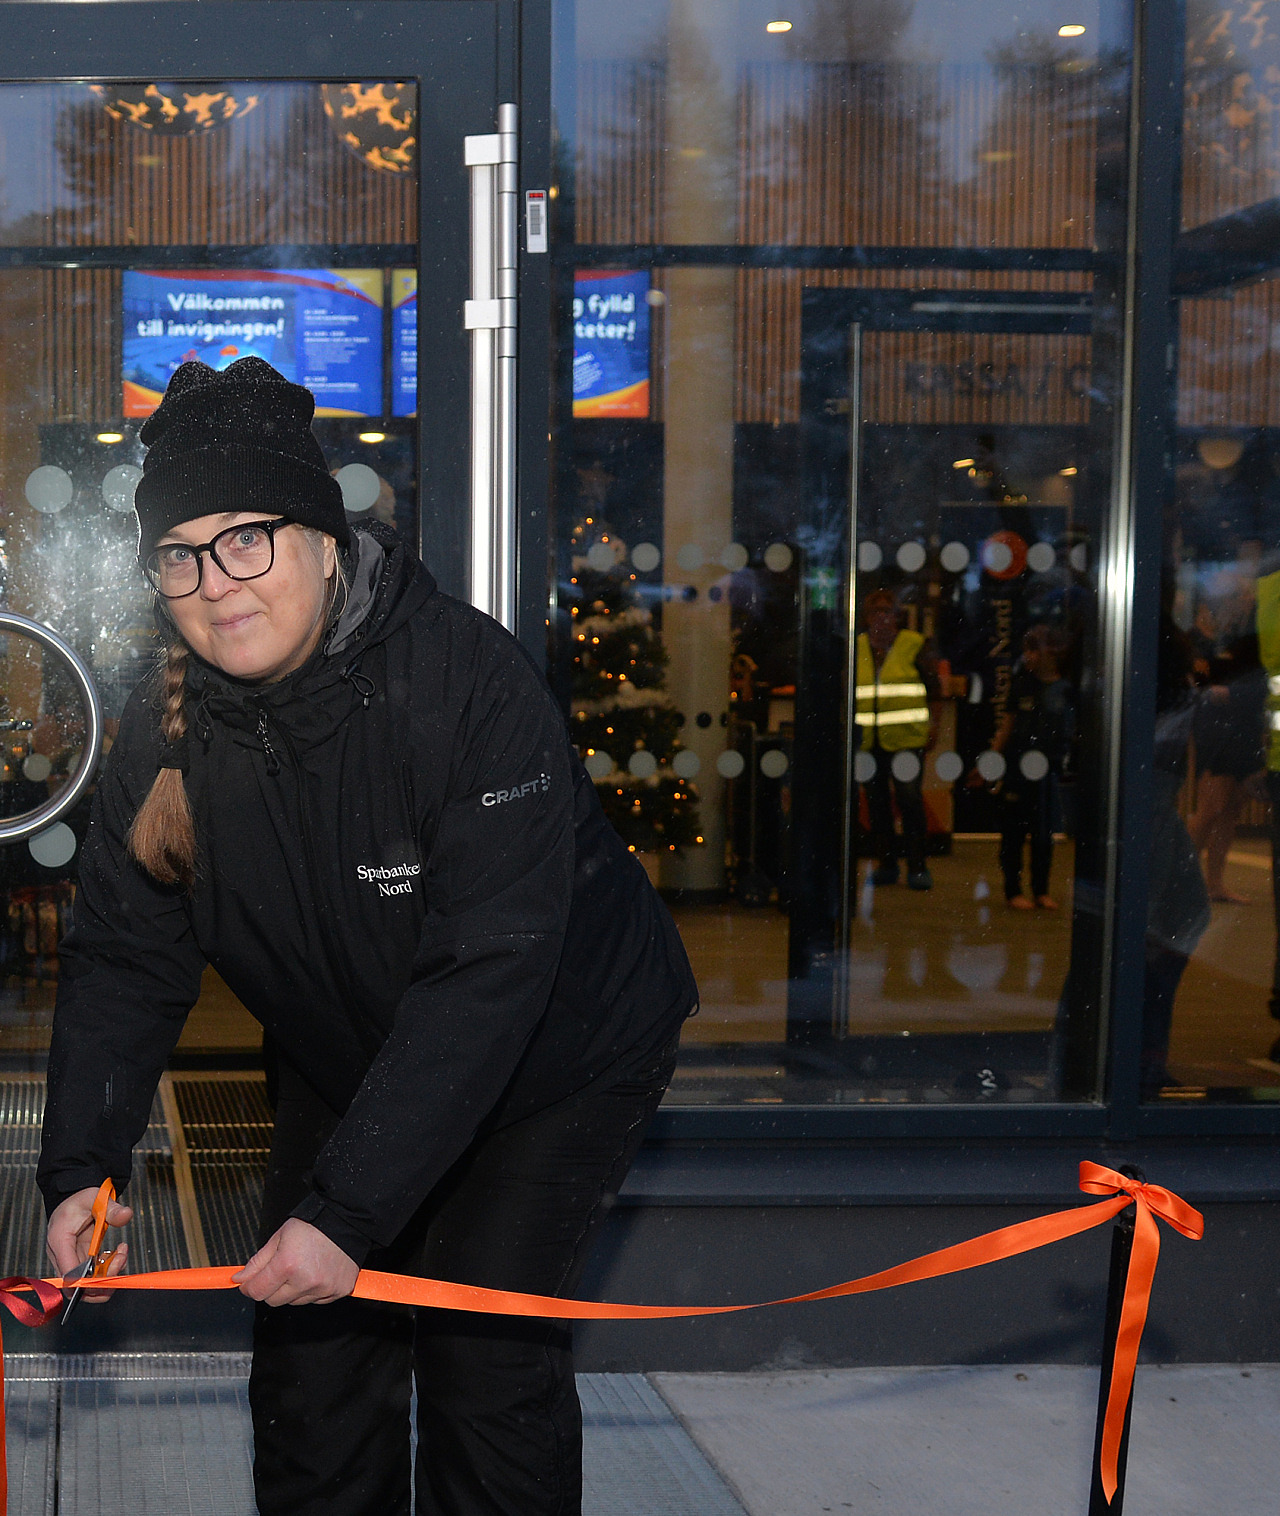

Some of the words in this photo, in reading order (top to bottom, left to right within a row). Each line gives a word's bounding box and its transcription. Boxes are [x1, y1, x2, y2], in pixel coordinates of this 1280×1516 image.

[167, 293, 285, 311] Välkommen
[588, 292, 635, 319] fylld
[137, 318, 164, 336] till
[167, 317, 285, 342] invigningen!
[574, 319, 636, 341] teter!
[988, 600, 1013, 658] Nord
[481, 779, 540, 807] CRAFT
[378, 880, 413, 897] Nord
